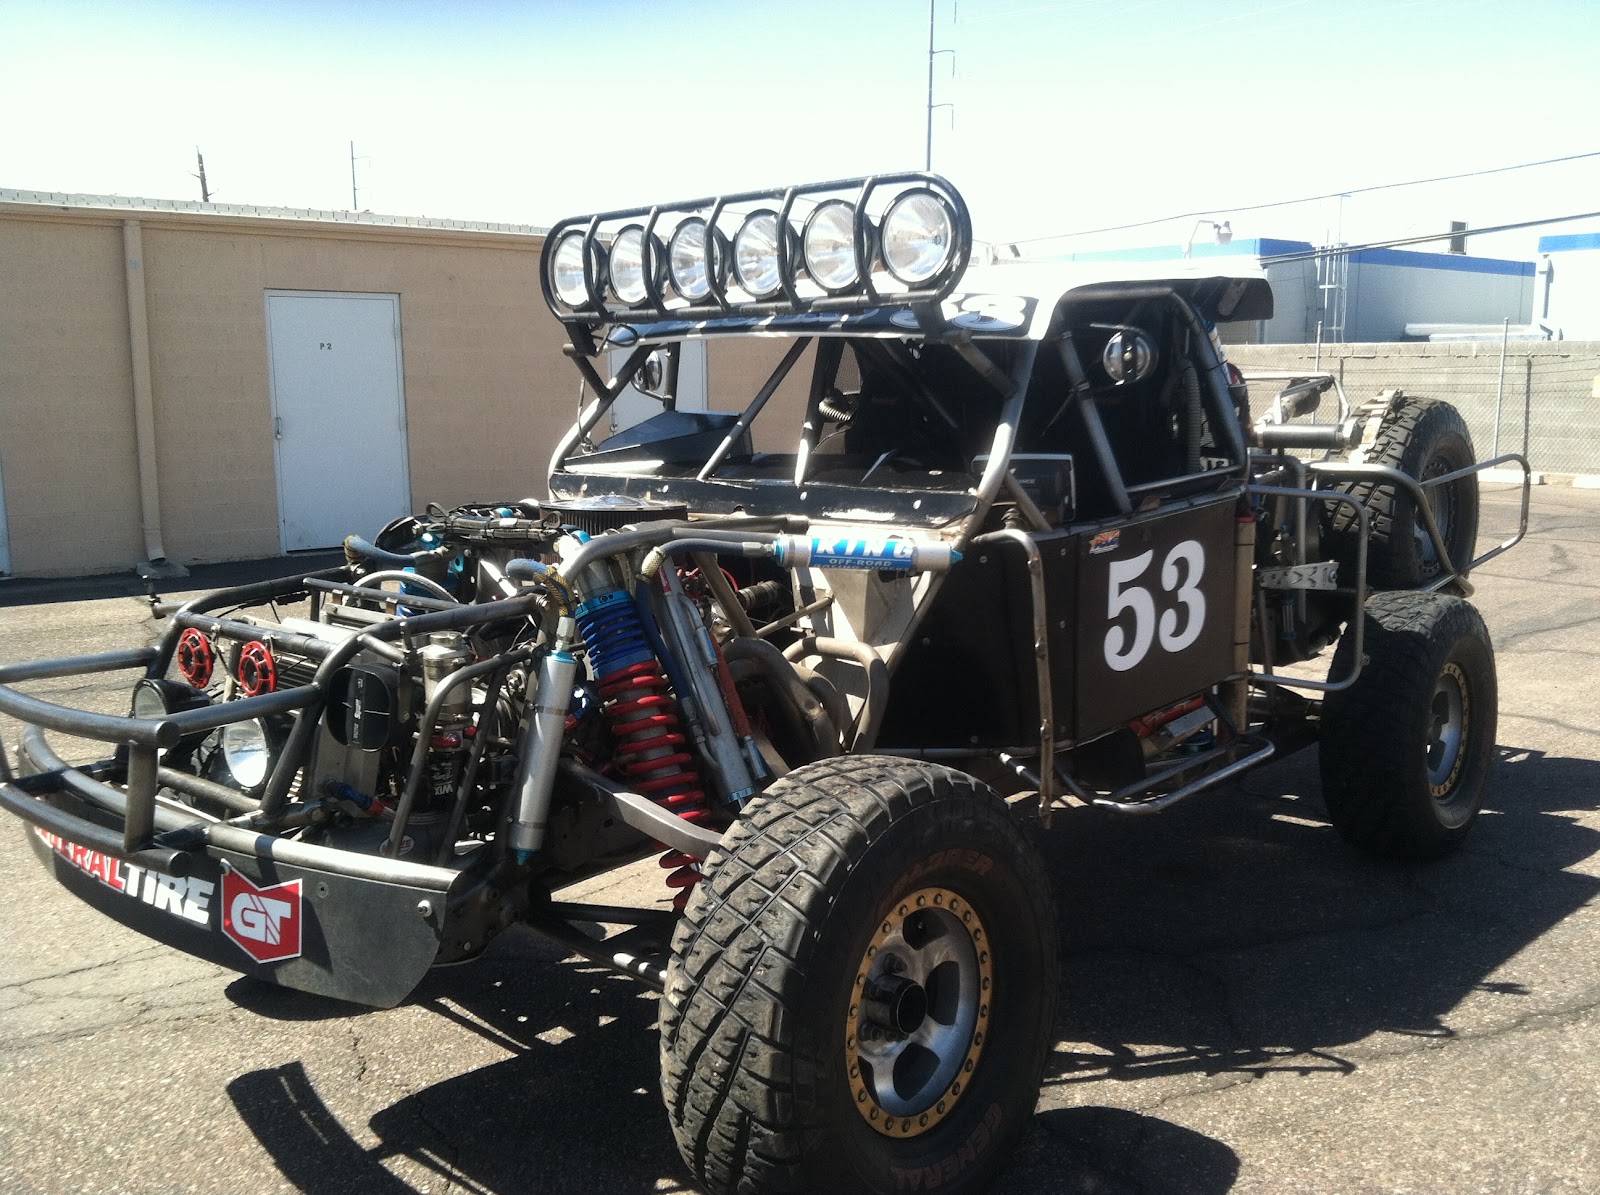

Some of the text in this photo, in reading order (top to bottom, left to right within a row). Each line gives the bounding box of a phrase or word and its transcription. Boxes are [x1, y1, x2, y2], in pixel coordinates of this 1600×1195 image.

[815, 537, 914, 558] KING
[829, 558, 892, 567] OFF-ROAD
[1103, 539, 1206, 672] 53
[433, 784, 454, 796] WIX
[124, 862, 215, 925] TIRE
[230, 891, 292, 946] GT
